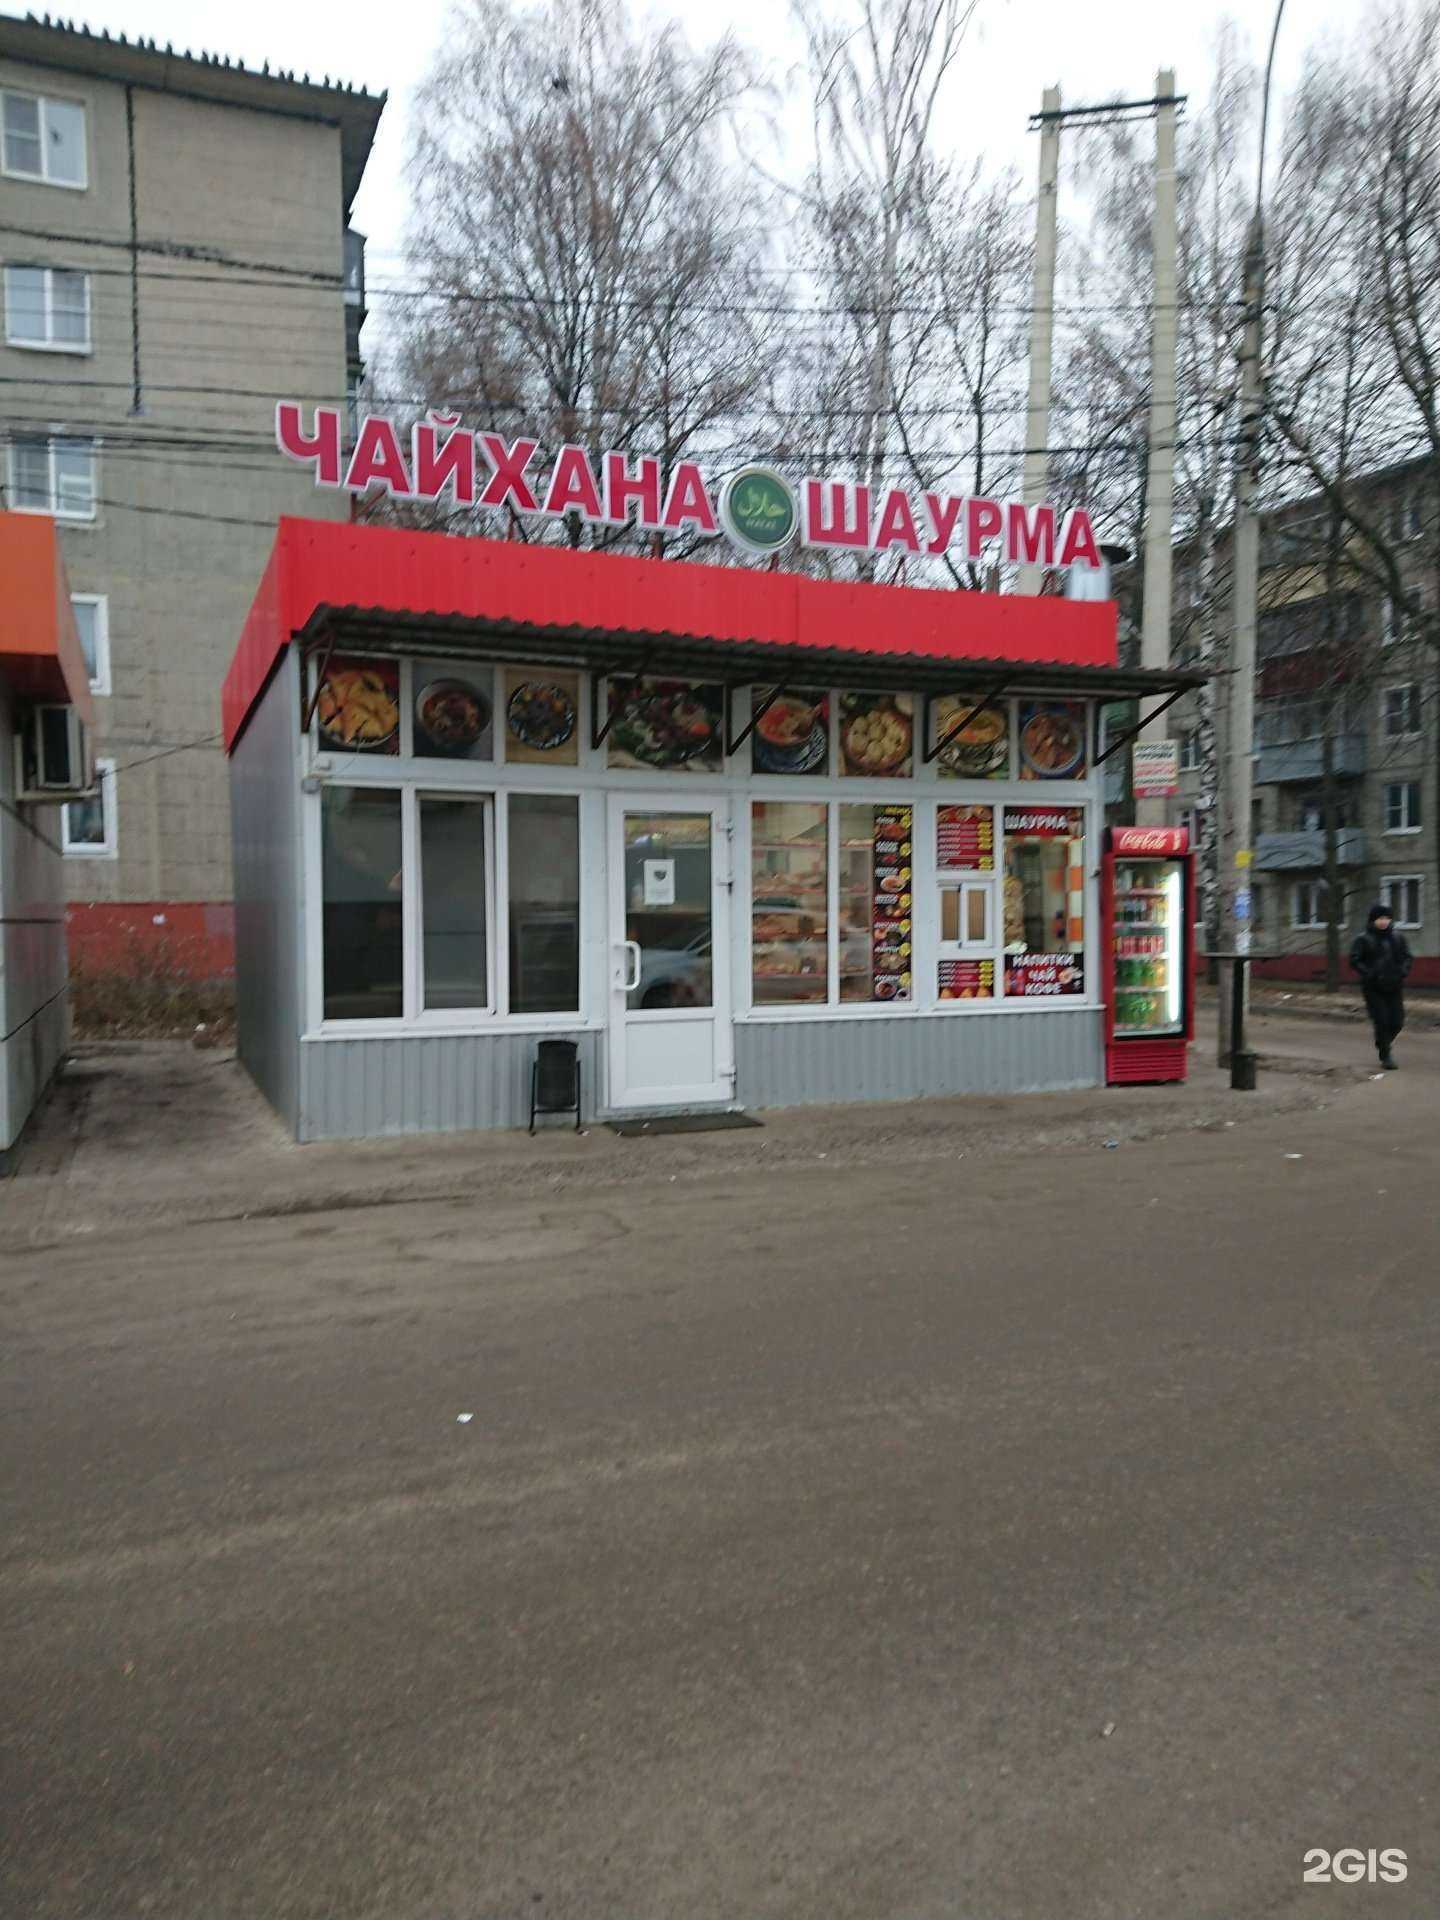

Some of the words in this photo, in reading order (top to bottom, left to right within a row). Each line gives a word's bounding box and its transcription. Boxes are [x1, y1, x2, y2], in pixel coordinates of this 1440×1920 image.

[276, 401, 719, 535] ЧАЙХАНА
[803, 477, 1102, 569] ШАУРМА
[1005, 814, 1067, 830] ШАУРМА
[1013, 954, 1074, 967] НАПИТКИ
[1028, 967, 1057, 981] ЧАЙ
